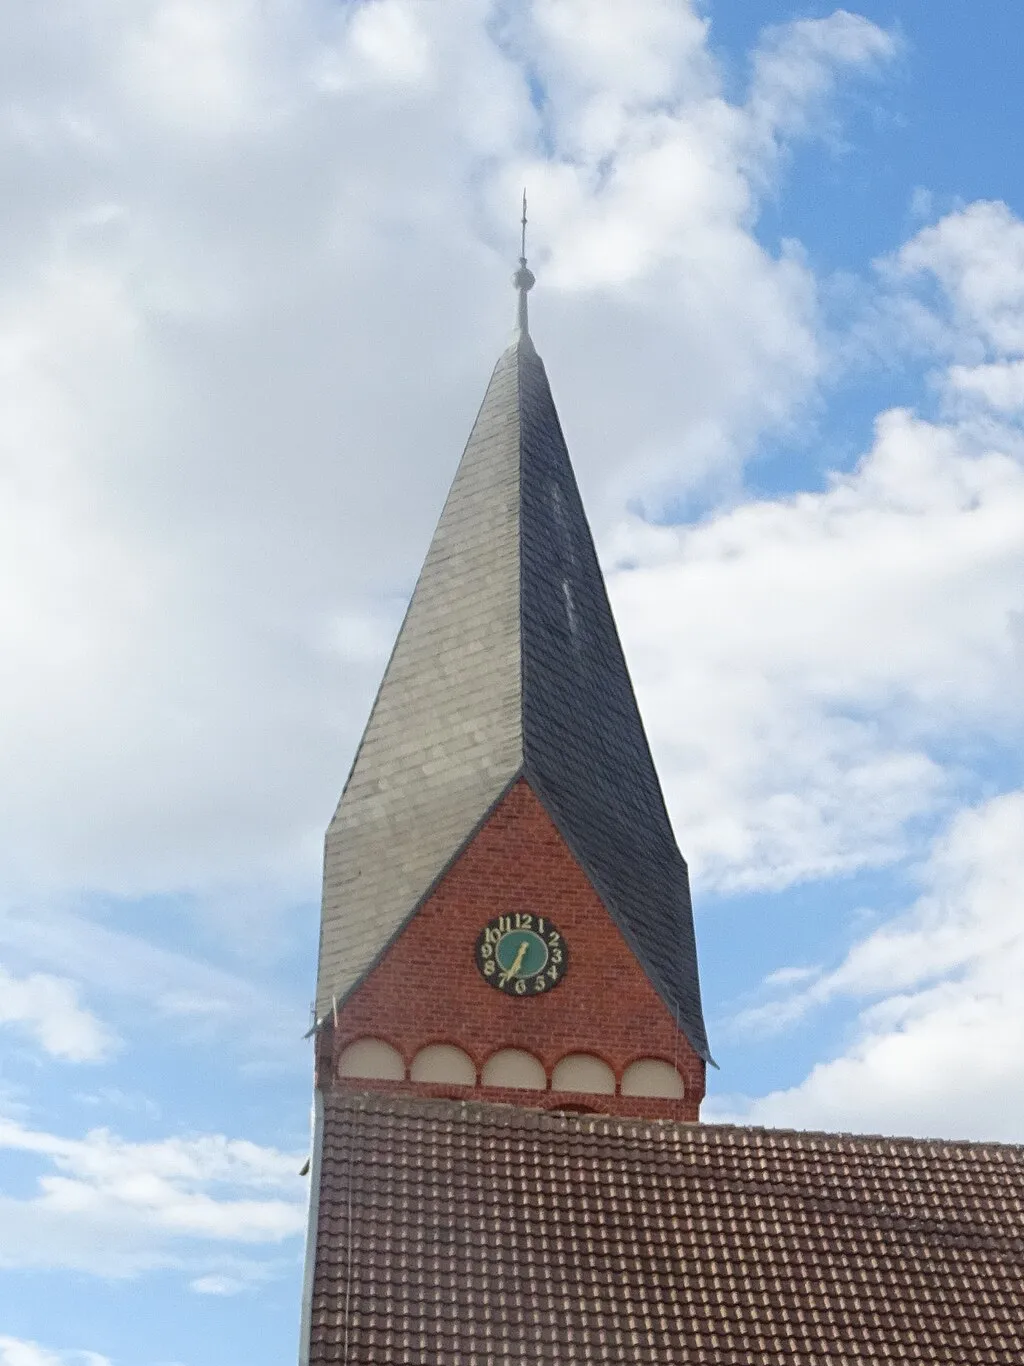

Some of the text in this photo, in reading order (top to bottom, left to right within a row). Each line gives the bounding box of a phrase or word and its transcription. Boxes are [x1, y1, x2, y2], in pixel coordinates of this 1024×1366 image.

[499, 916, 511, 932] 11
[515, 913, 533, 929] 12
[539, 918, 544, 934] 1
[484, 928, 502, 943] 10
[548, 931, 560, 946] 2
[481, 943, 493, 958] 9
[551, 948, 562, 963] 3
[484, 960, 495, 976] 8
[547, 965, 558, 980] 4
[499, 972, 510, 988] 7
[515, 979, 526, 994] 6
[535, 976, 546, 991] 5
